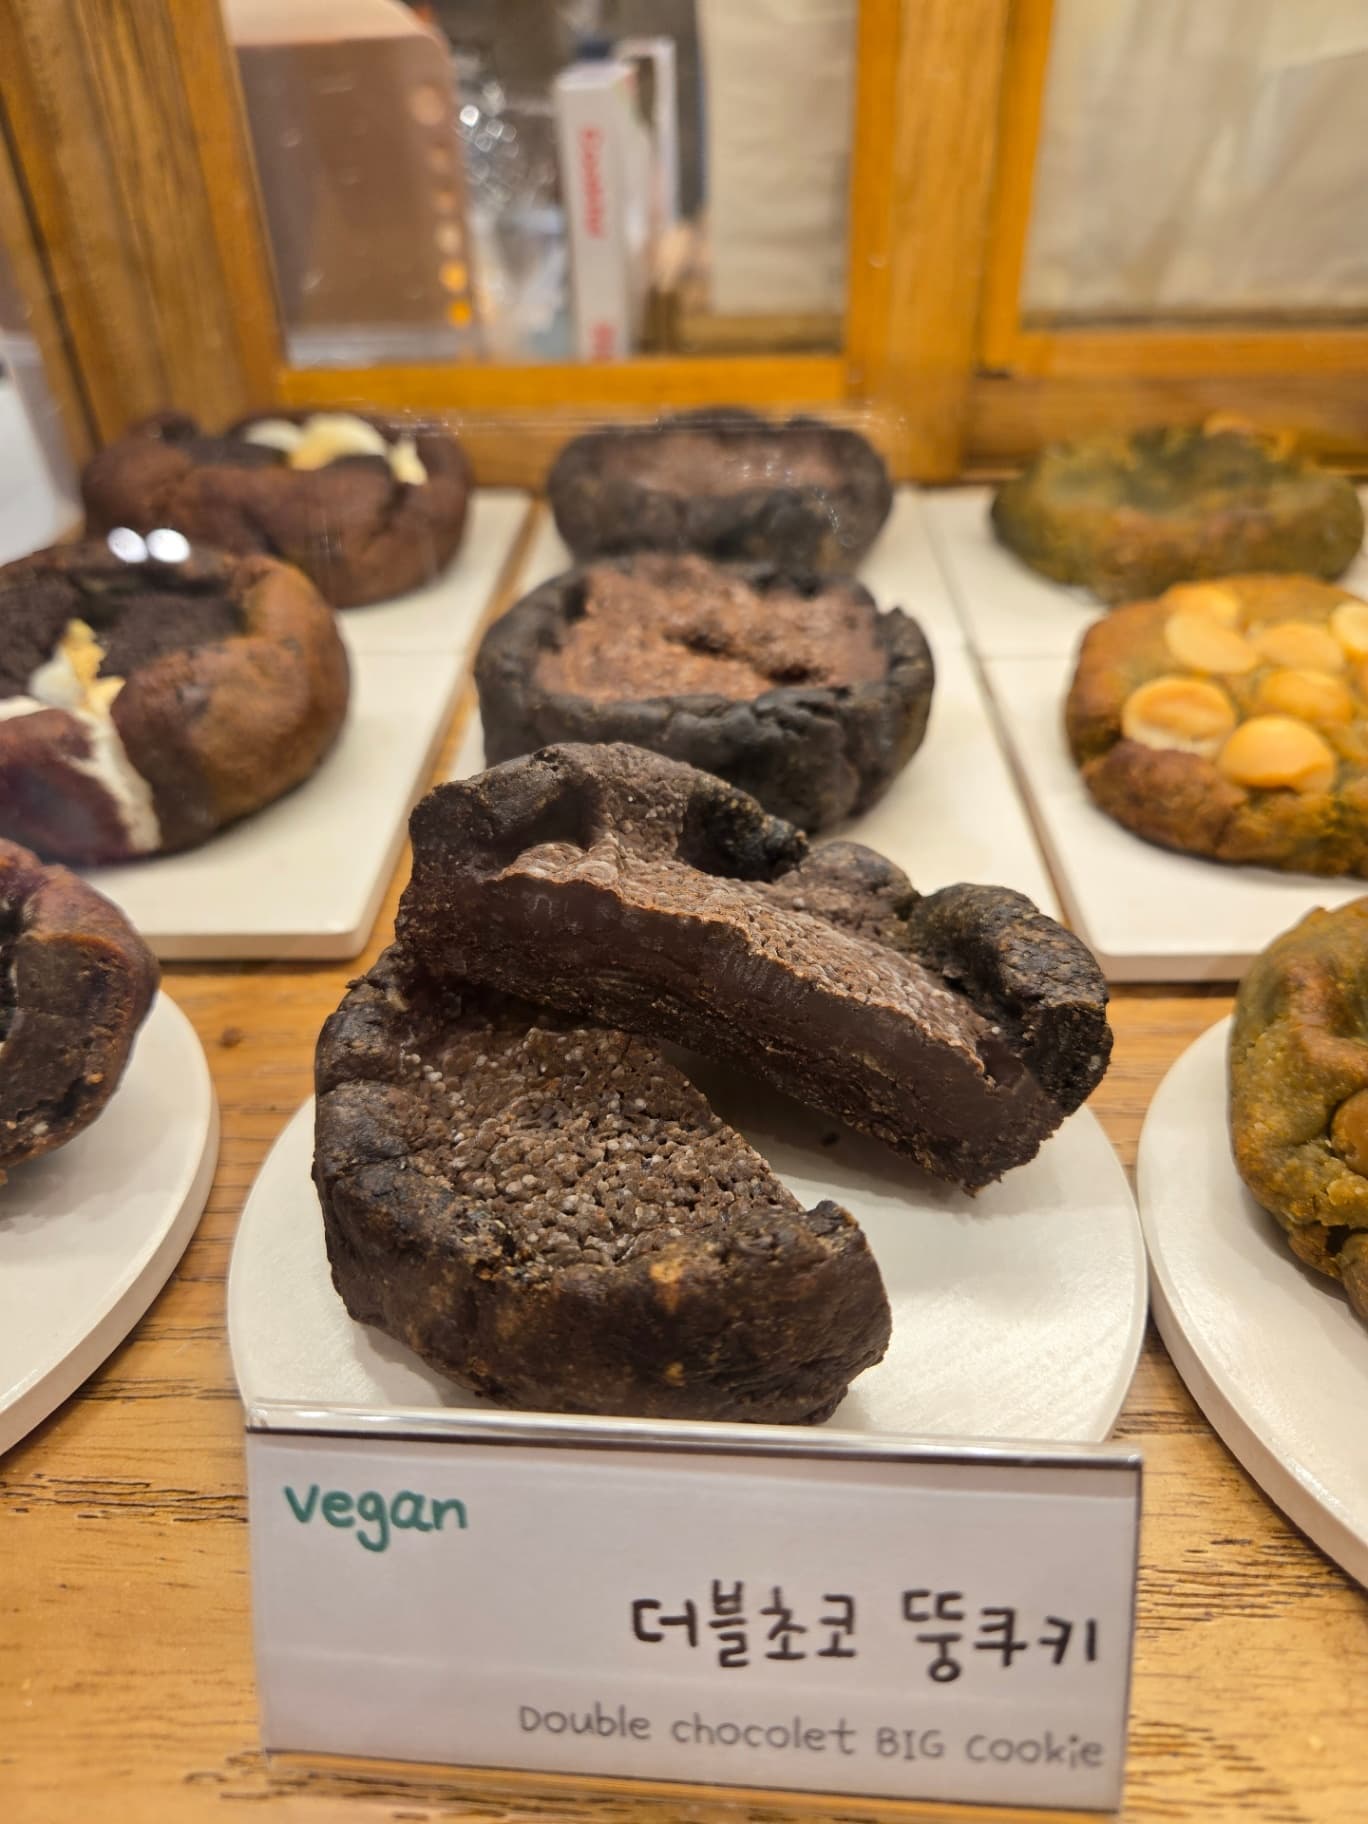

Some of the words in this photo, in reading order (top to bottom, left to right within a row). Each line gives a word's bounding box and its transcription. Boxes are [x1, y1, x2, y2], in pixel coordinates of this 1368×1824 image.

[631, 1579, 857, 1669] 더블초코
[902, 1588, 1098, 1683] 뚱쿠키
[519, 1702, 652, 1741] Double
[671, 1711, 857, 1756] chocolet
[876, 1726, 945, 1761] BIG
